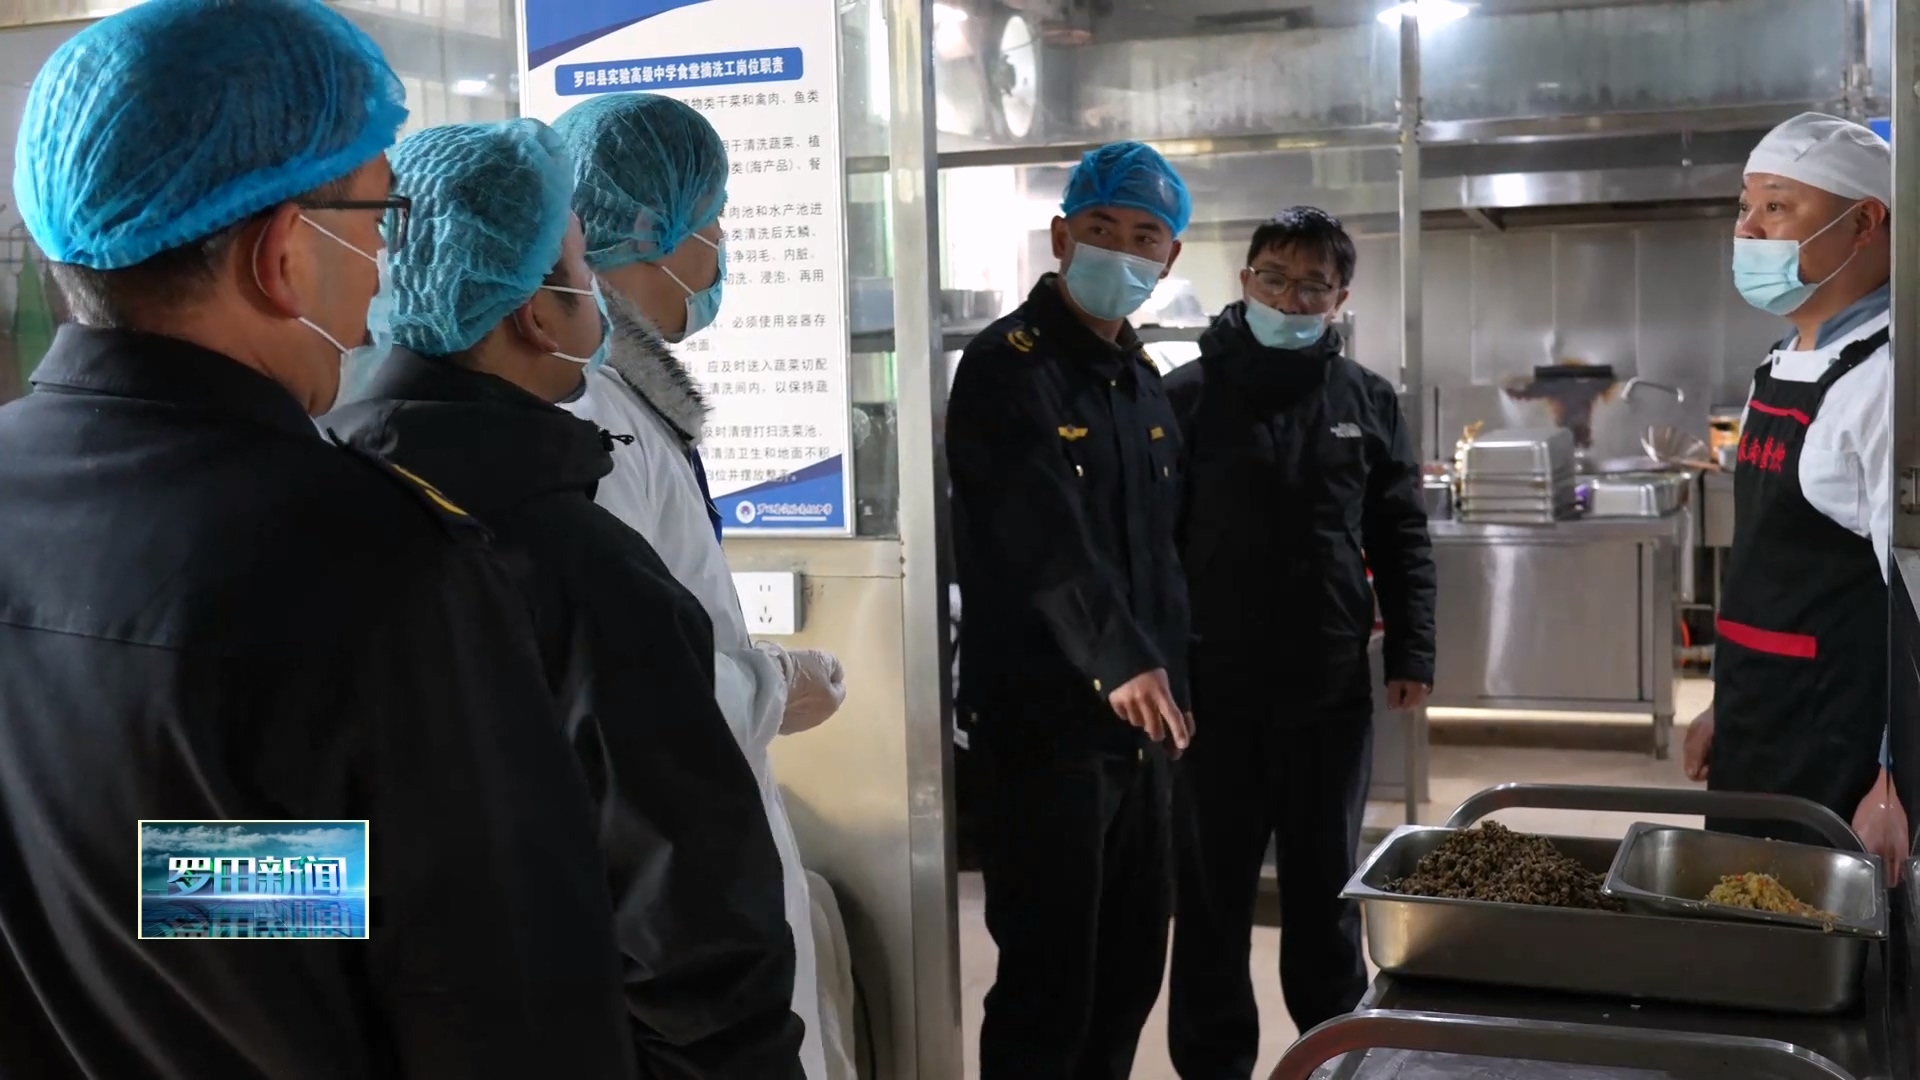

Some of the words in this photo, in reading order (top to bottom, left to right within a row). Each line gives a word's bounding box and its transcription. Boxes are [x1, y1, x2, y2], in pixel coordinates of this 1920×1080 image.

[573, 56, 784, 88] 罗田县实验高级中学食堂摘洗工岗位职责
